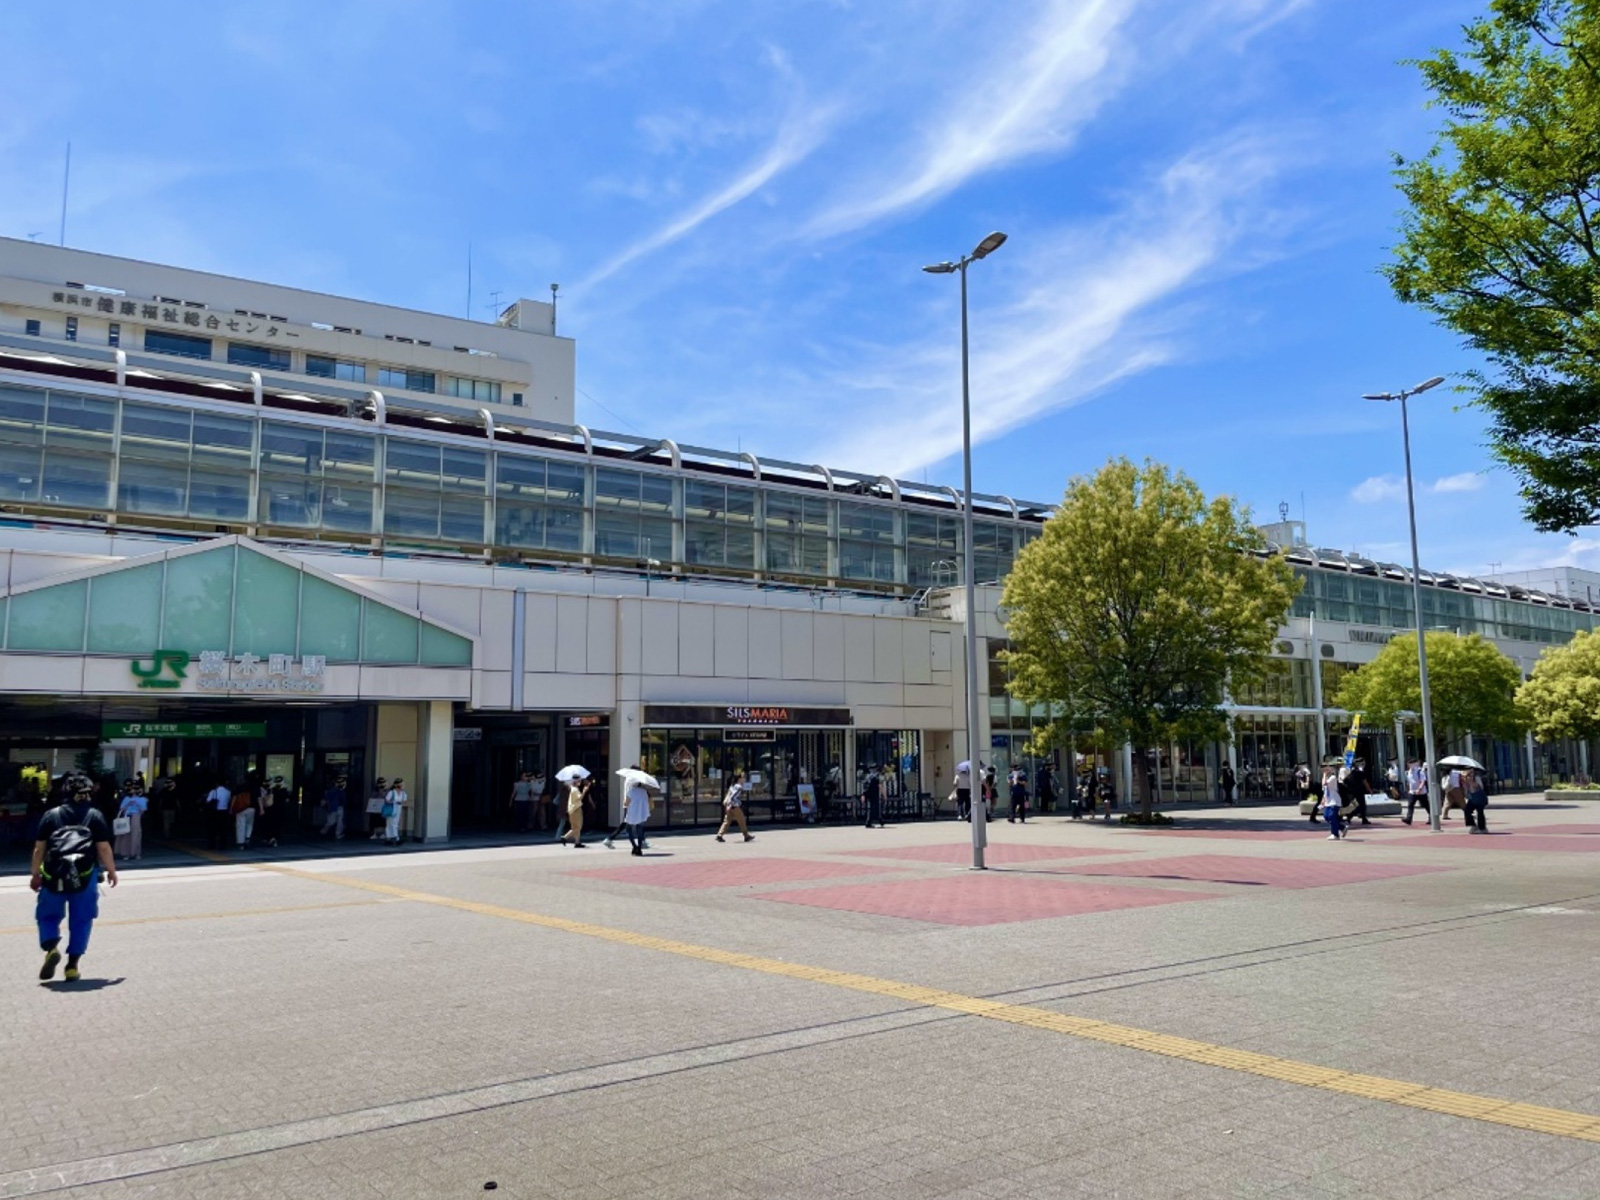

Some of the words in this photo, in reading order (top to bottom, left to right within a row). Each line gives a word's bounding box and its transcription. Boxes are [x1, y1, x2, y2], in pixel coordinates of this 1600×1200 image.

[131, 649, 190, 678] JR
[198, 650, 326, 677] 桜木町駅
[122, 723, 142, 733] JR
